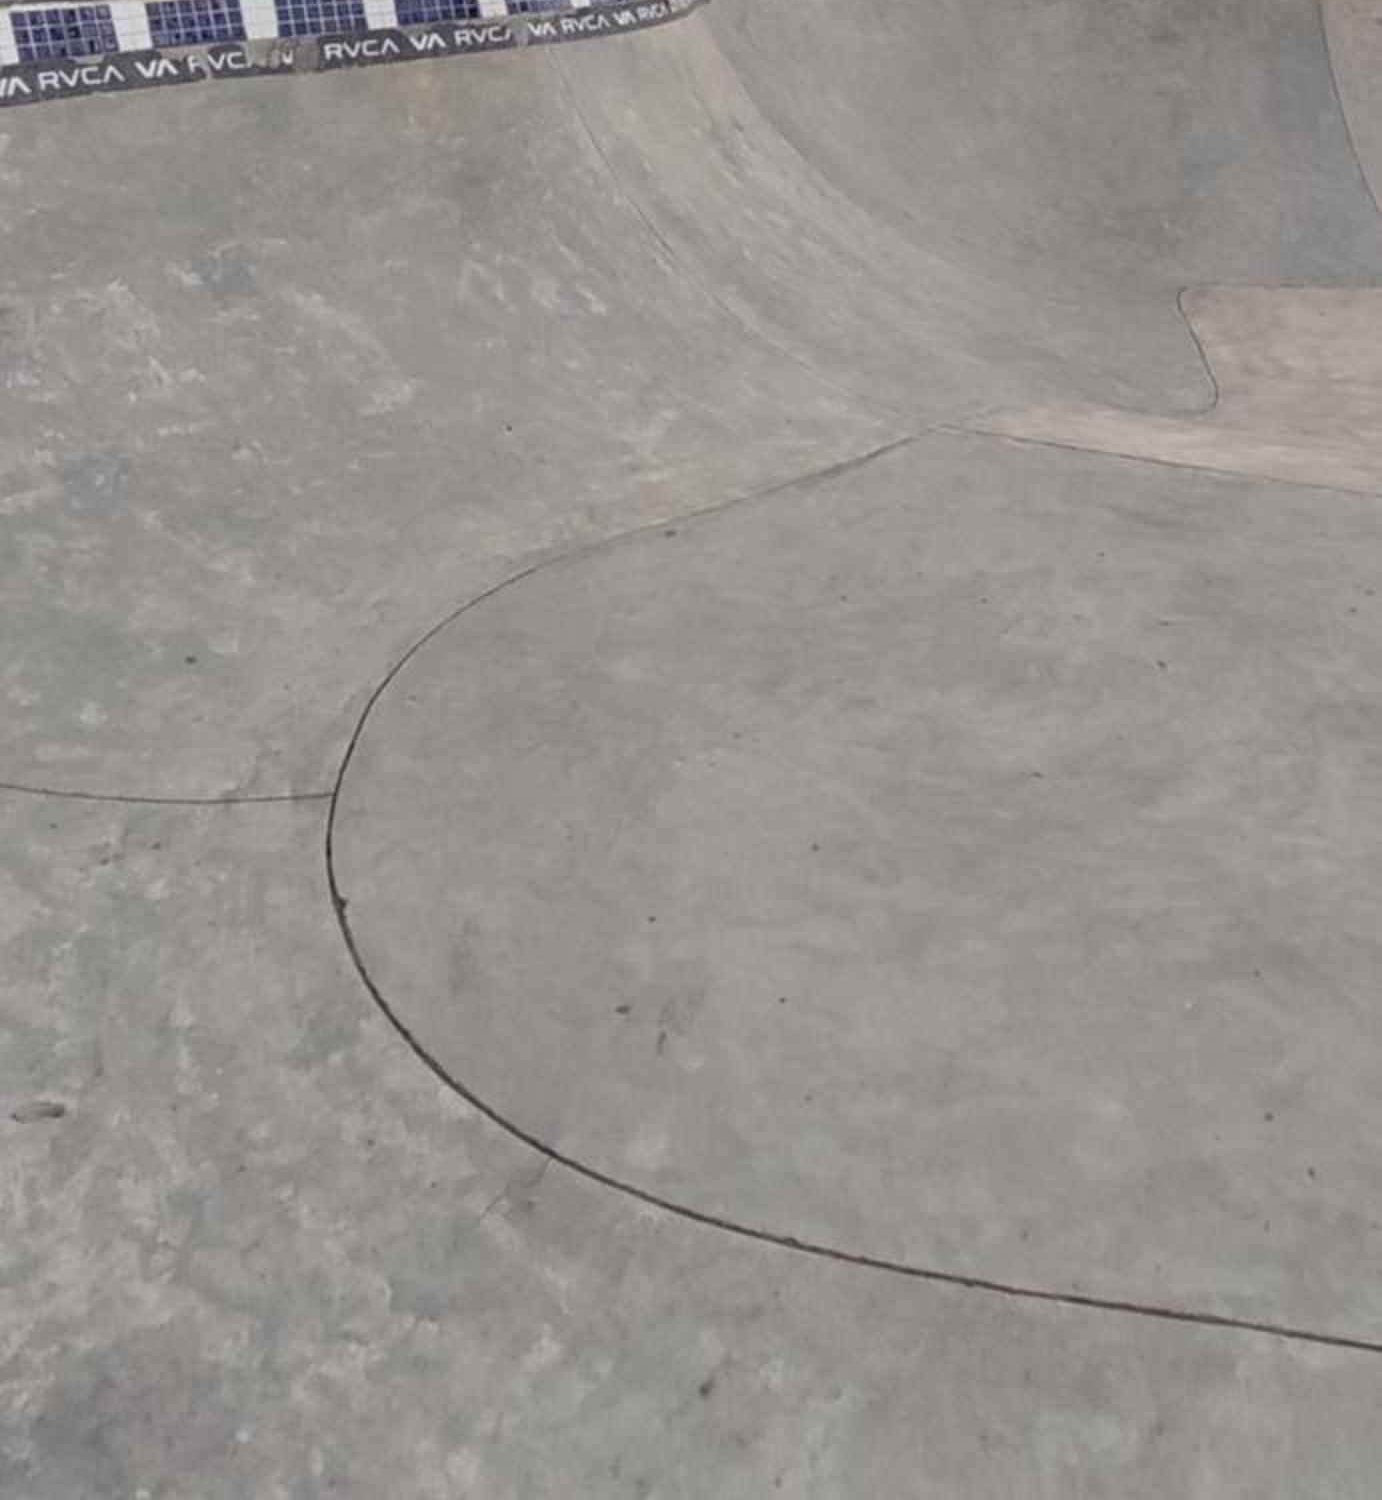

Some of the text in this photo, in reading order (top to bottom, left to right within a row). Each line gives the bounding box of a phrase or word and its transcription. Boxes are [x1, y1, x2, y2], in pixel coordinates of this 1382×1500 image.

[38, 64, 124, 91] RVCA
[135, 59, 179, 79] VA
[187, 50, 253, 73] RVC
[324, 38, 400, 61] RVCA
[409, 32, 446, 51] VA
[527, 21, 557, 37] VA
[560, 13, 610, 35] RVCA
[612, 9, 637, 25] VA
